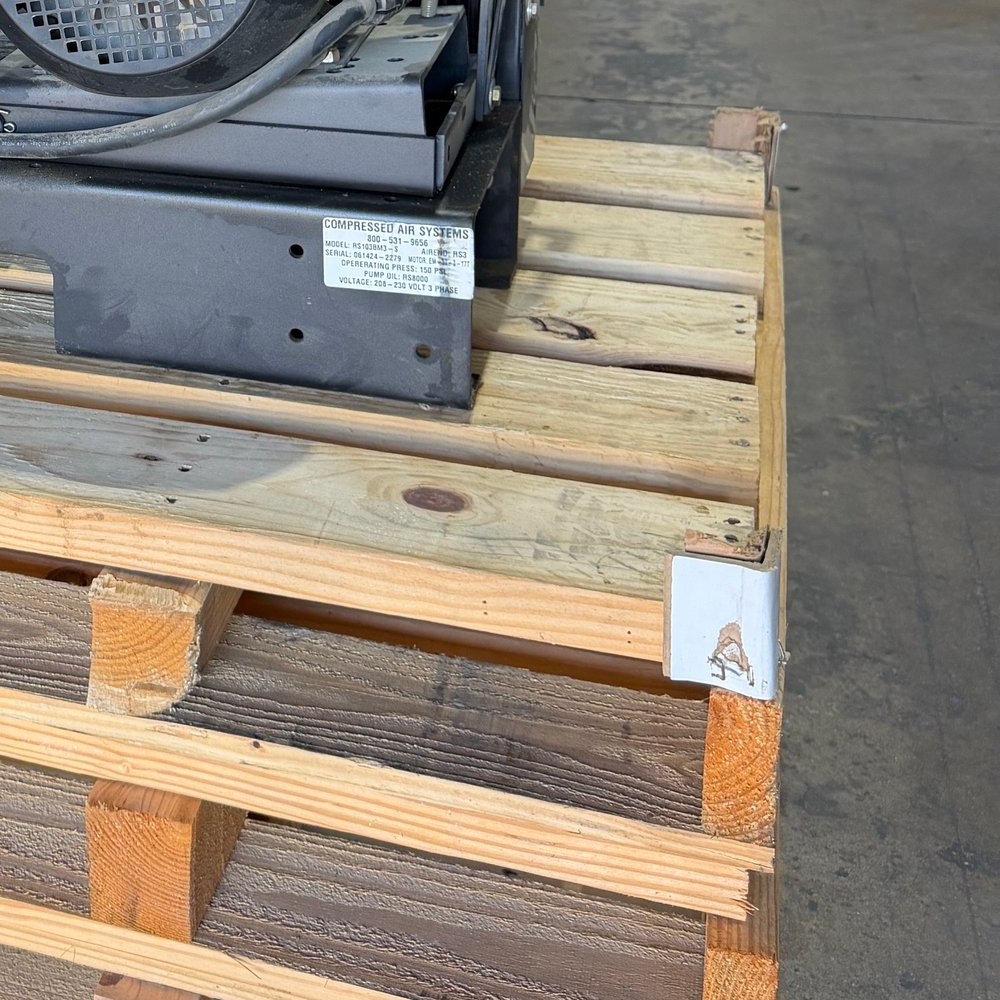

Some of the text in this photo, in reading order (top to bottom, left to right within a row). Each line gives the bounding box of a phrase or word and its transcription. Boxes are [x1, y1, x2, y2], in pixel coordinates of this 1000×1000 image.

[324, 219, 469, 240] COMPRESSED AIR SYSTEMS
[367, 234, 428, 247] 800-531-9656
[325, 240, 350, 248] MODEL:
[453, 250, 467, 259] RS3
[325, 249, 351, 258] SERIAL:
[341, 259, 390, 270] OPERERATING
[391, 263, 417, 273] PRESS:
[420, 266, 432, 274] 150
[364, 270, 384, 279] PUMP
[386, 272, 400, 280] OIL:
[339, 276, 458, 294] VOLTAGE: 208-230 VOLT 3 PHASE
